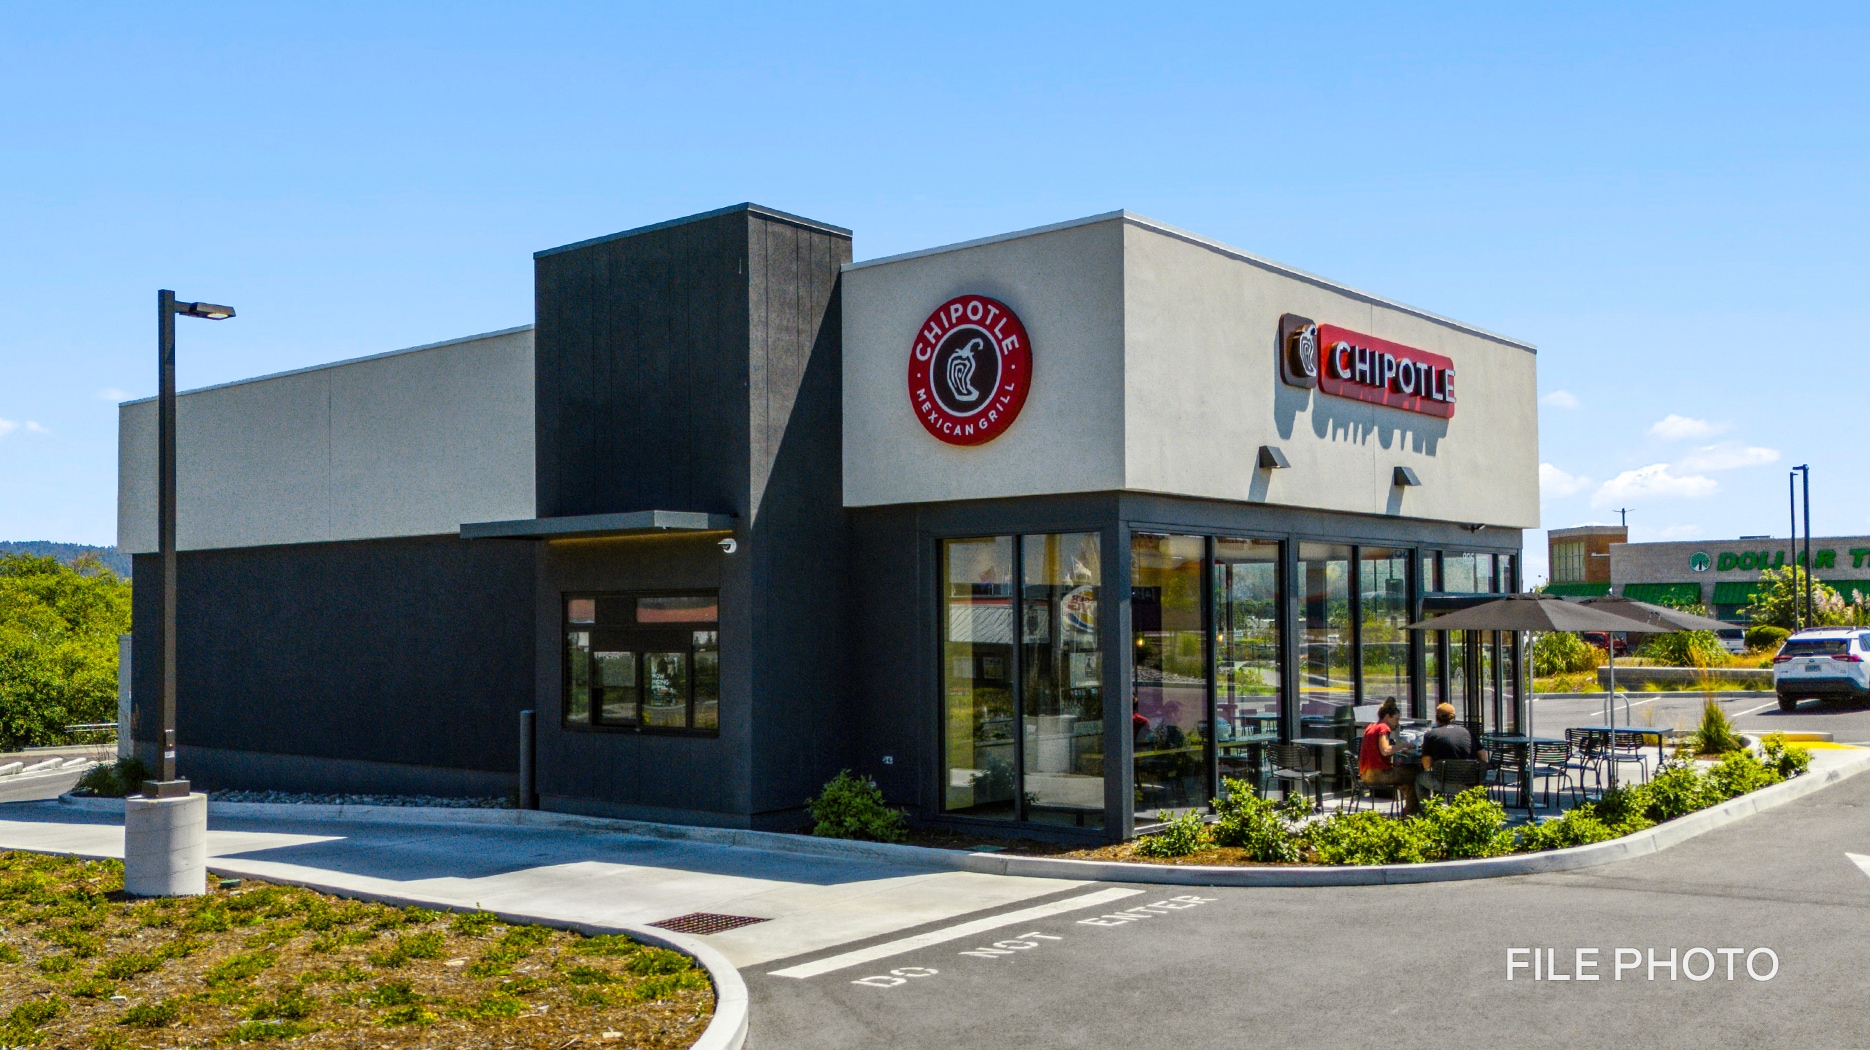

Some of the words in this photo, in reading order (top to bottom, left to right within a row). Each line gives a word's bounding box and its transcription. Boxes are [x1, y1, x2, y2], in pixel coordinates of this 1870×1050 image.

[915, 300, 1020, 361] CHIPOTLE
[1333, 340, 1457, 404] CHIPOTLE
[916, 388, 974, 436] MEXICAN
[978, 382, 1015, 430] GRILL
[1849, 548, 1870, 569] T
[850, 966, 939, 988] DO
[957, 931, 1063, 959] NOT
[1075, 894, 1219, 927] ENTER
